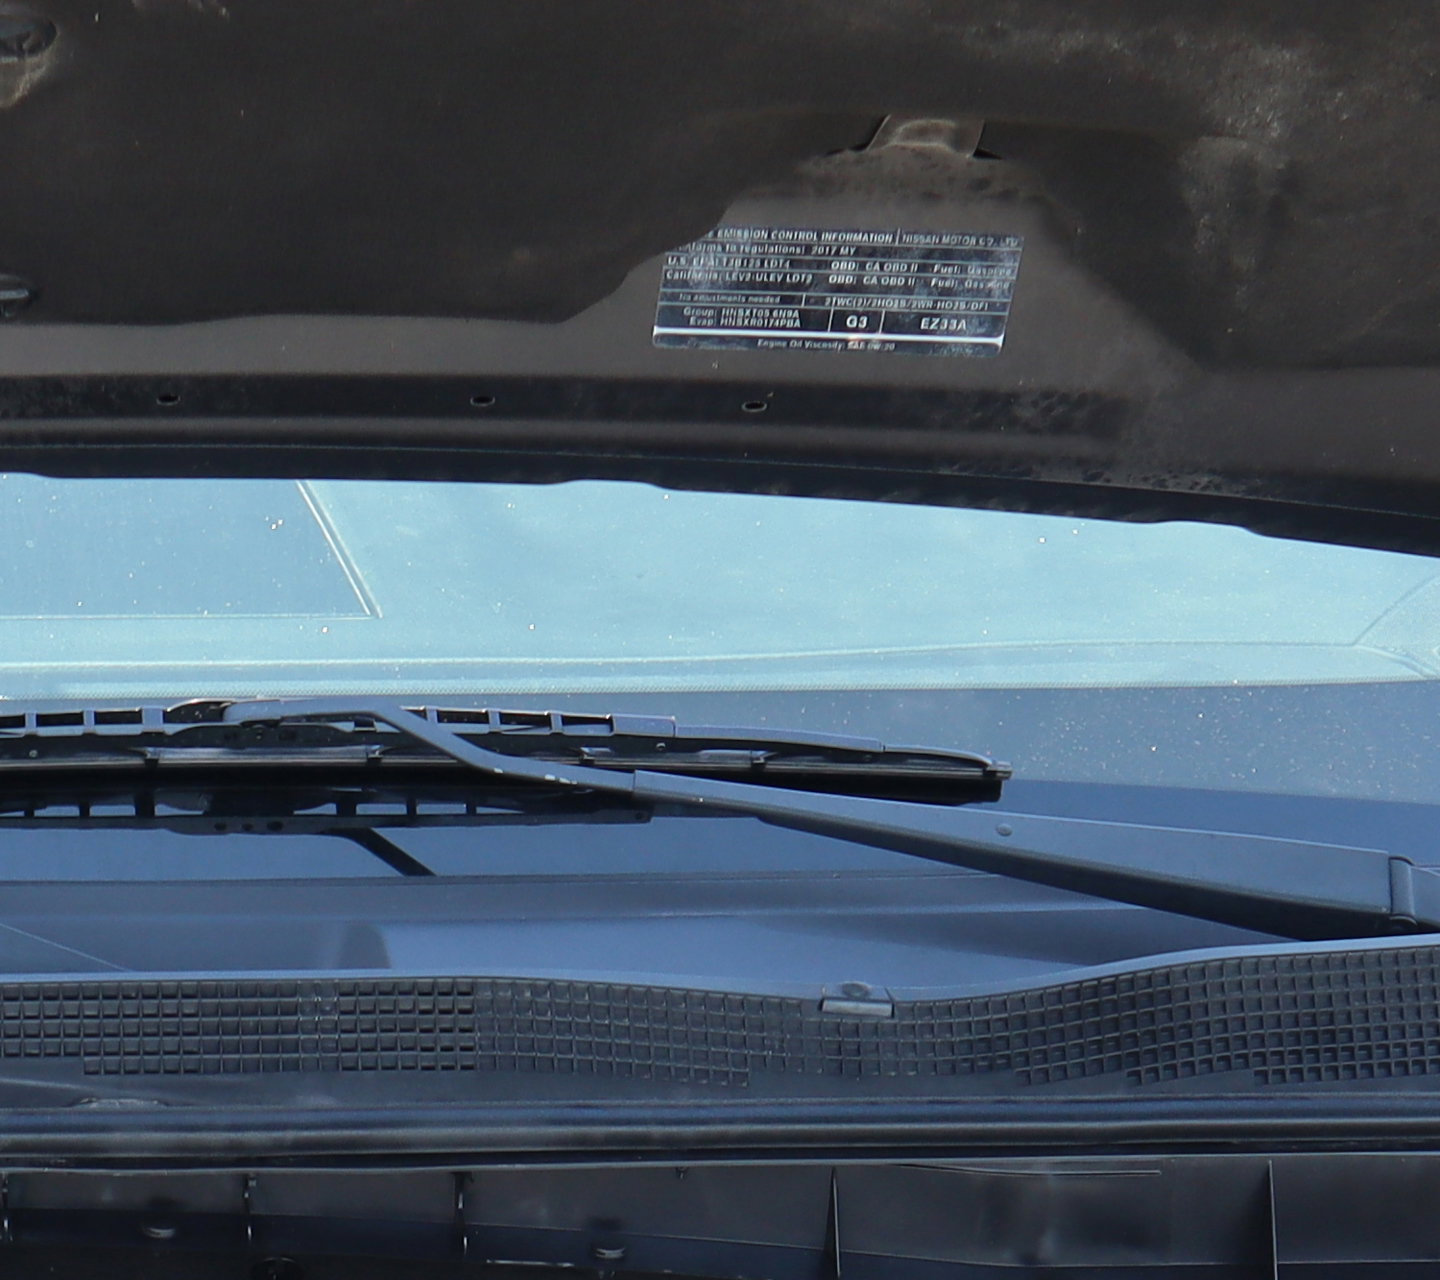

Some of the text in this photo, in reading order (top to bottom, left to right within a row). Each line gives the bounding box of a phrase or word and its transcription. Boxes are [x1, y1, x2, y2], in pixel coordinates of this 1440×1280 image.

[717, 228, 769, 240] EMISSION
[771, 230, 817, 241] CONTROL
[821, 231, 892, 244] INFORMATION
[902, 233, 939, 245] NISSAN
[942, 234, 976, 245] MOTOR
[726, 242, 736, 253] to
[811, 245, 836, 255] 2017
[839, 245, 856, 256] MY
[763, 259, 791, 270] LDT4
[866, 262, 880, 272] CA
[883, 263, 908, 273] OBD
[910, 263, 918, 273] II
[863, 275, 878, 285] CA
[881, 276, 905, 286] OBD
[908, 277, 916, 286] II
[748, 295, 781, 304] needed
[846, 315, 868, 329] G3
[920, 317, 967, 331] EZ33A
[757, 338, 788, 348] Engine
[789, 339, 802, 348] Oil
